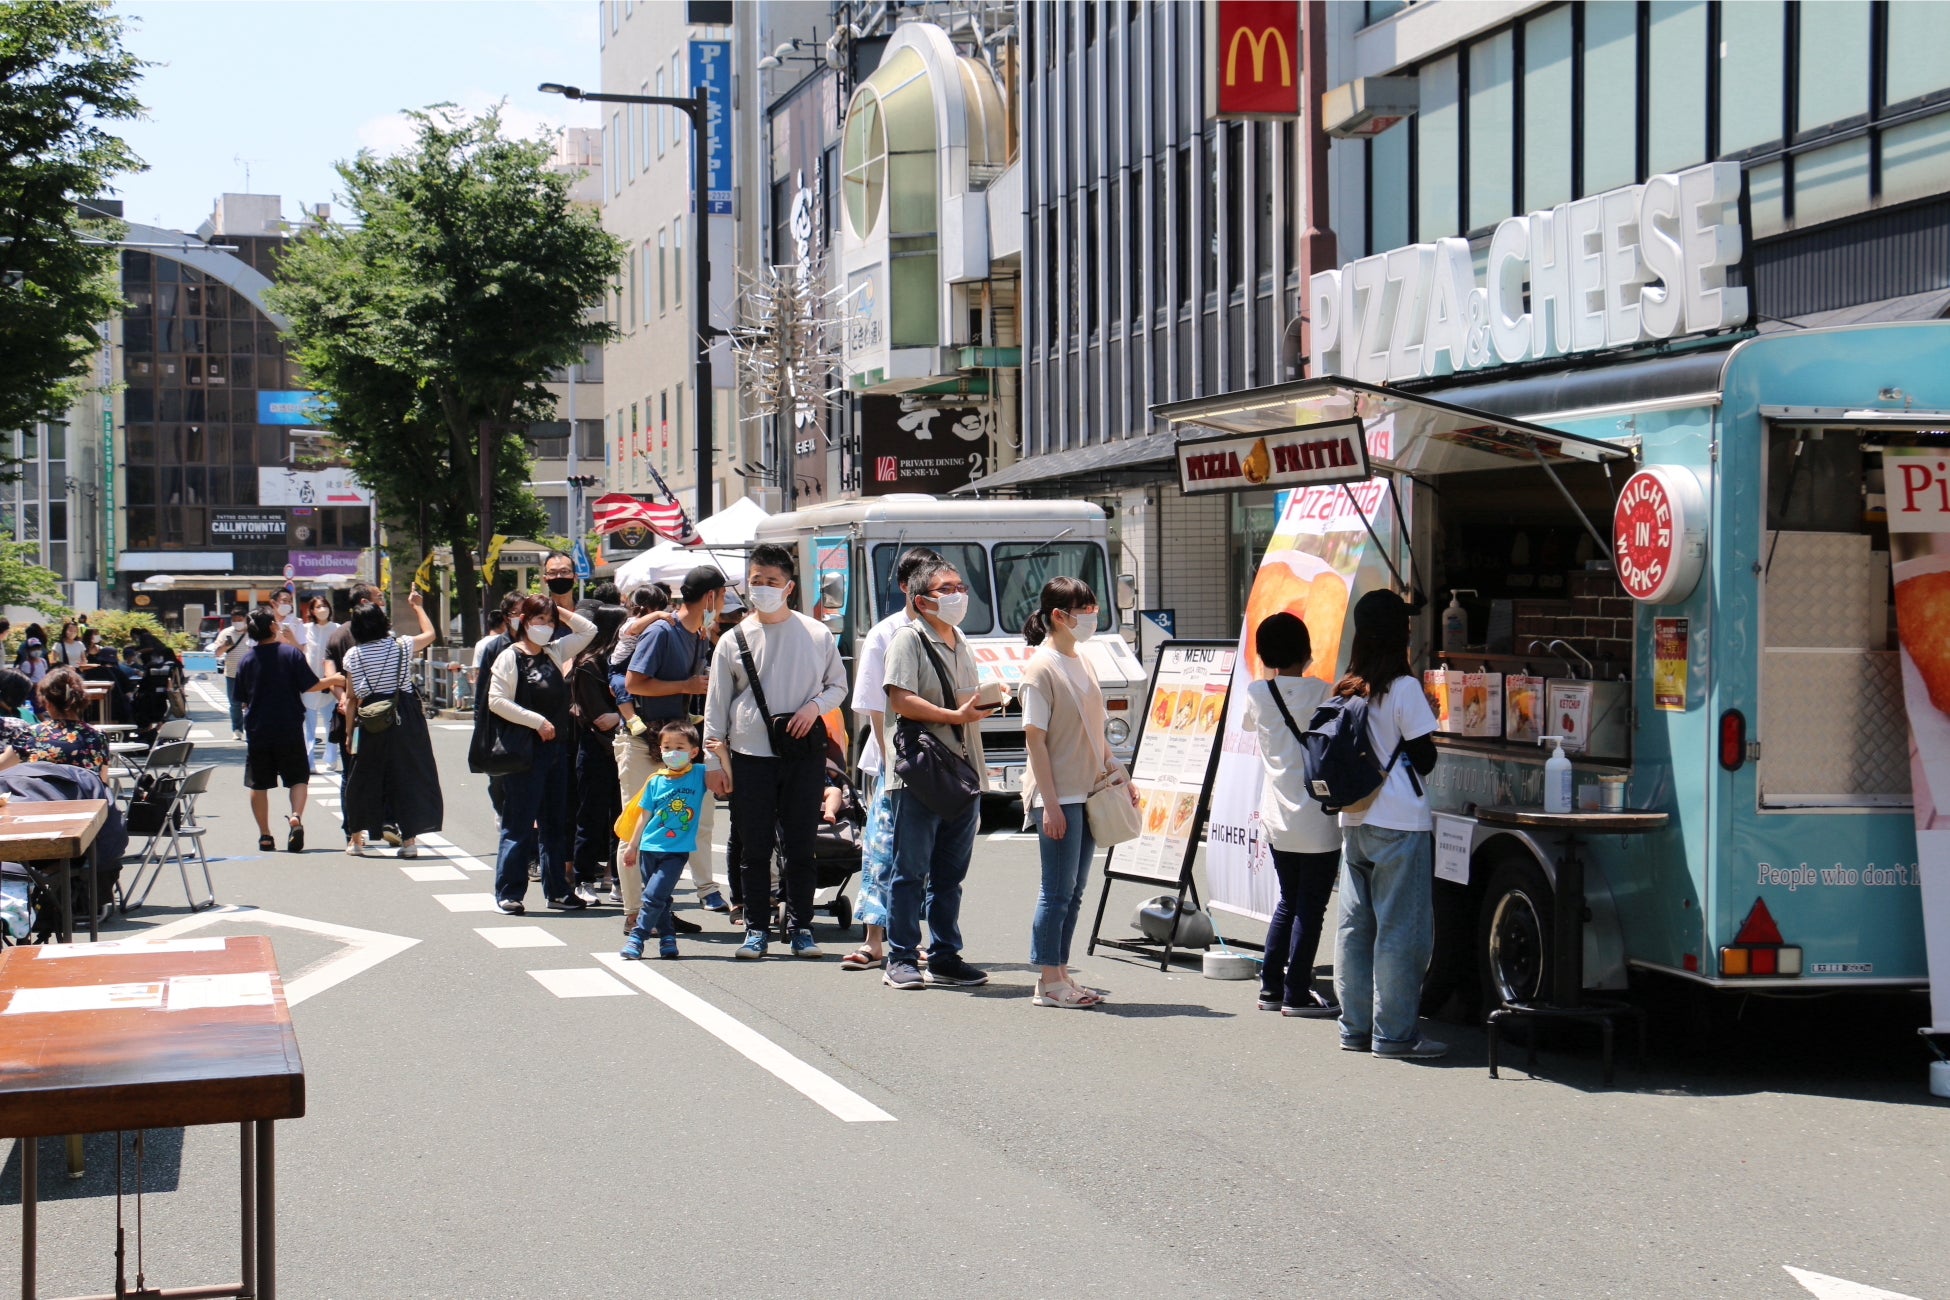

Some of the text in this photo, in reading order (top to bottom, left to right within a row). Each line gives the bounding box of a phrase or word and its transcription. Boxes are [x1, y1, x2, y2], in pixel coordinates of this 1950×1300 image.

[900, 459, 934, 468] PRIVATE
[936, 457, 965, 466] DINING
[1185, 451, 1243, 481] PIZZA
[1271, 437, 1358, 474] FRITTA
[900, 468, 939, 477] NE-NE-YA
[1622, 479, 1670, 548] HIGHER
[1635, 522, 1650, 547] IN
[1616, 533, 1662, 591] WORKS
[1184, 648, 1216, 663] MENU
[1211, 822, 1246, 846] HIGHER
[1757, 862, 1817, 892] People
[1821, 862, 1859, 886] who
[1863, 862, 1908, 886] don't
